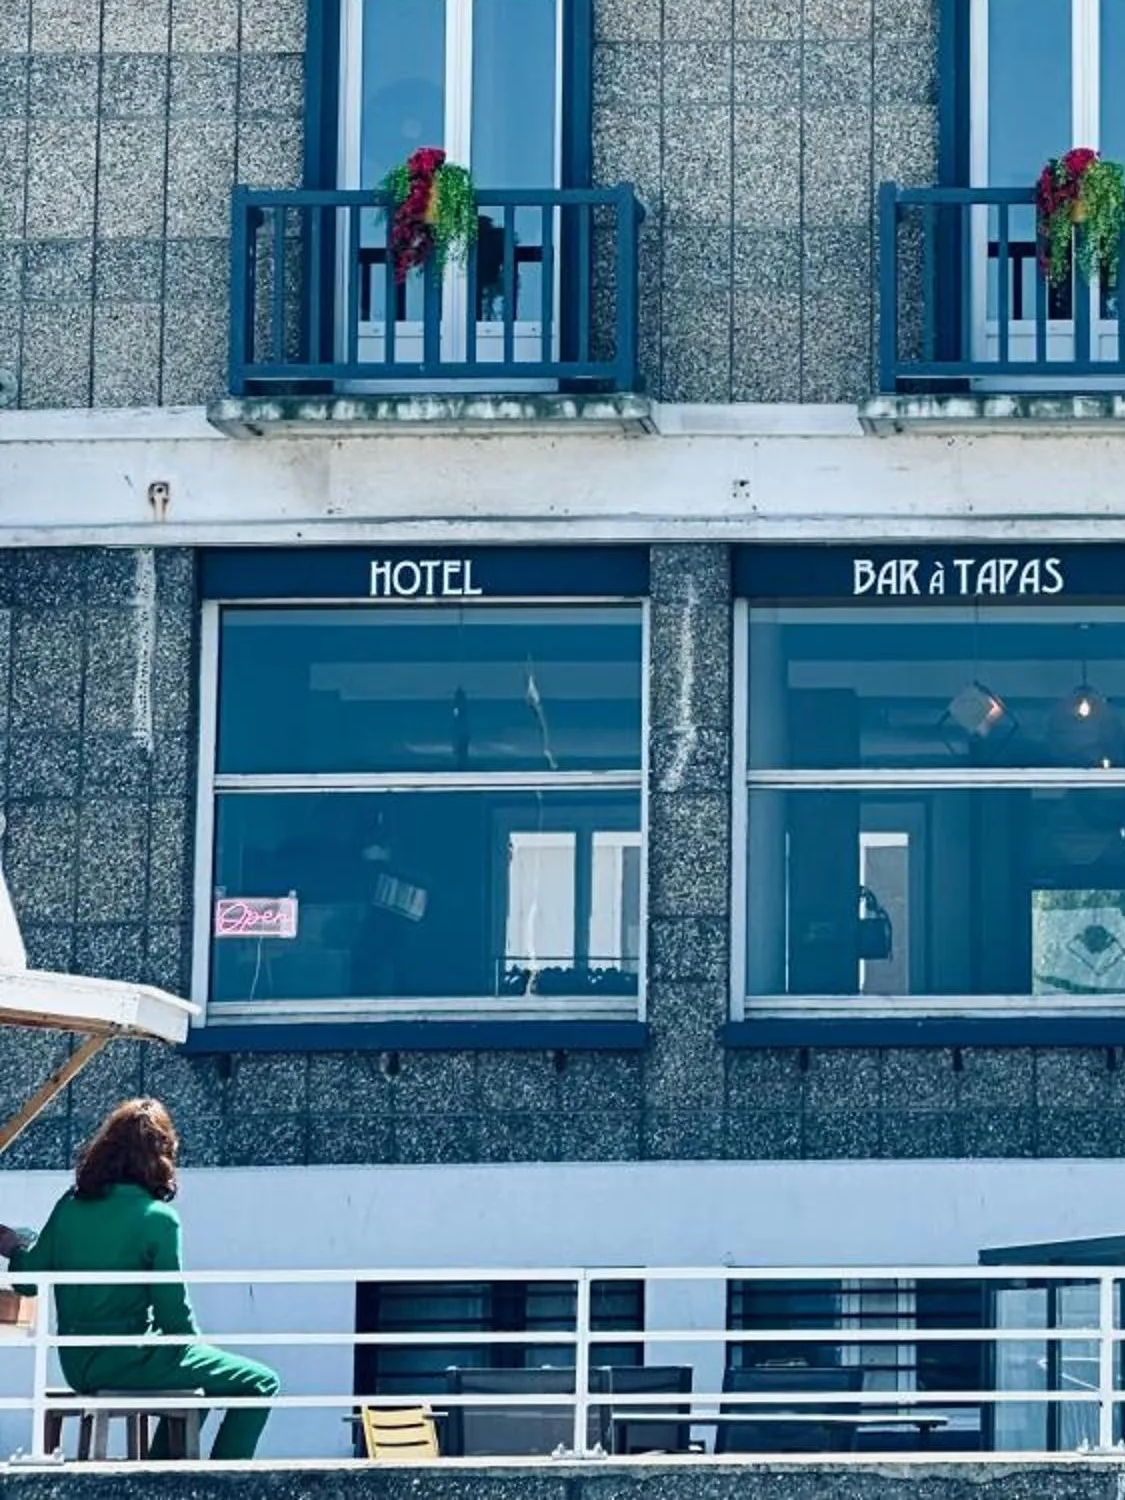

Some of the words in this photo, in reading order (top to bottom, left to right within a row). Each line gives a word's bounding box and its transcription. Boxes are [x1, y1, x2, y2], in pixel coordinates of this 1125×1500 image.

[370, 560, 483, 596] HOTEL
[853, 559, 921, 595] BAR
[953, 557, 1064, 595] TAPAS
[219, 903, 289, 933] Open
